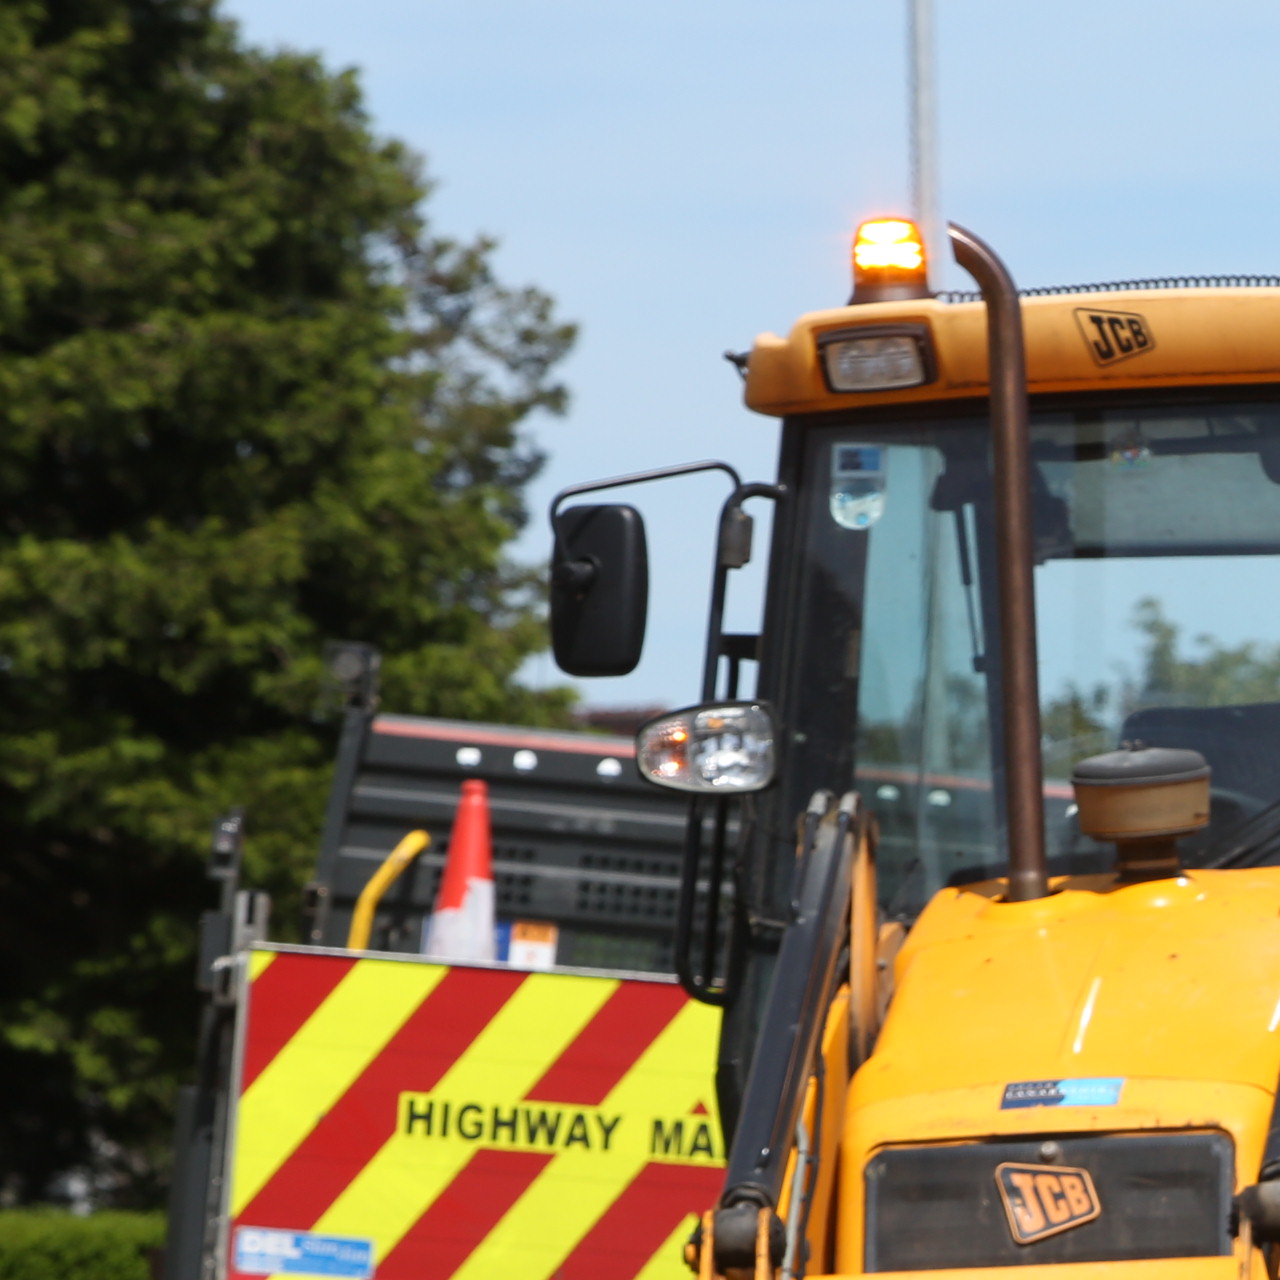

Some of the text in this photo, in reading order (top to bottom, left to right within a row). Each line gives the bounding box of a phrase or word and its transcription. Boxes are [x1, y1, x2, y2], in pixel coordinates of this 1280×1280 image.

[1088, 313, 1149, 361] JCB
[404, 1098, 724, 1160] HIGHWAY MA
[1009, 1172, 1092, 1233] JCB
